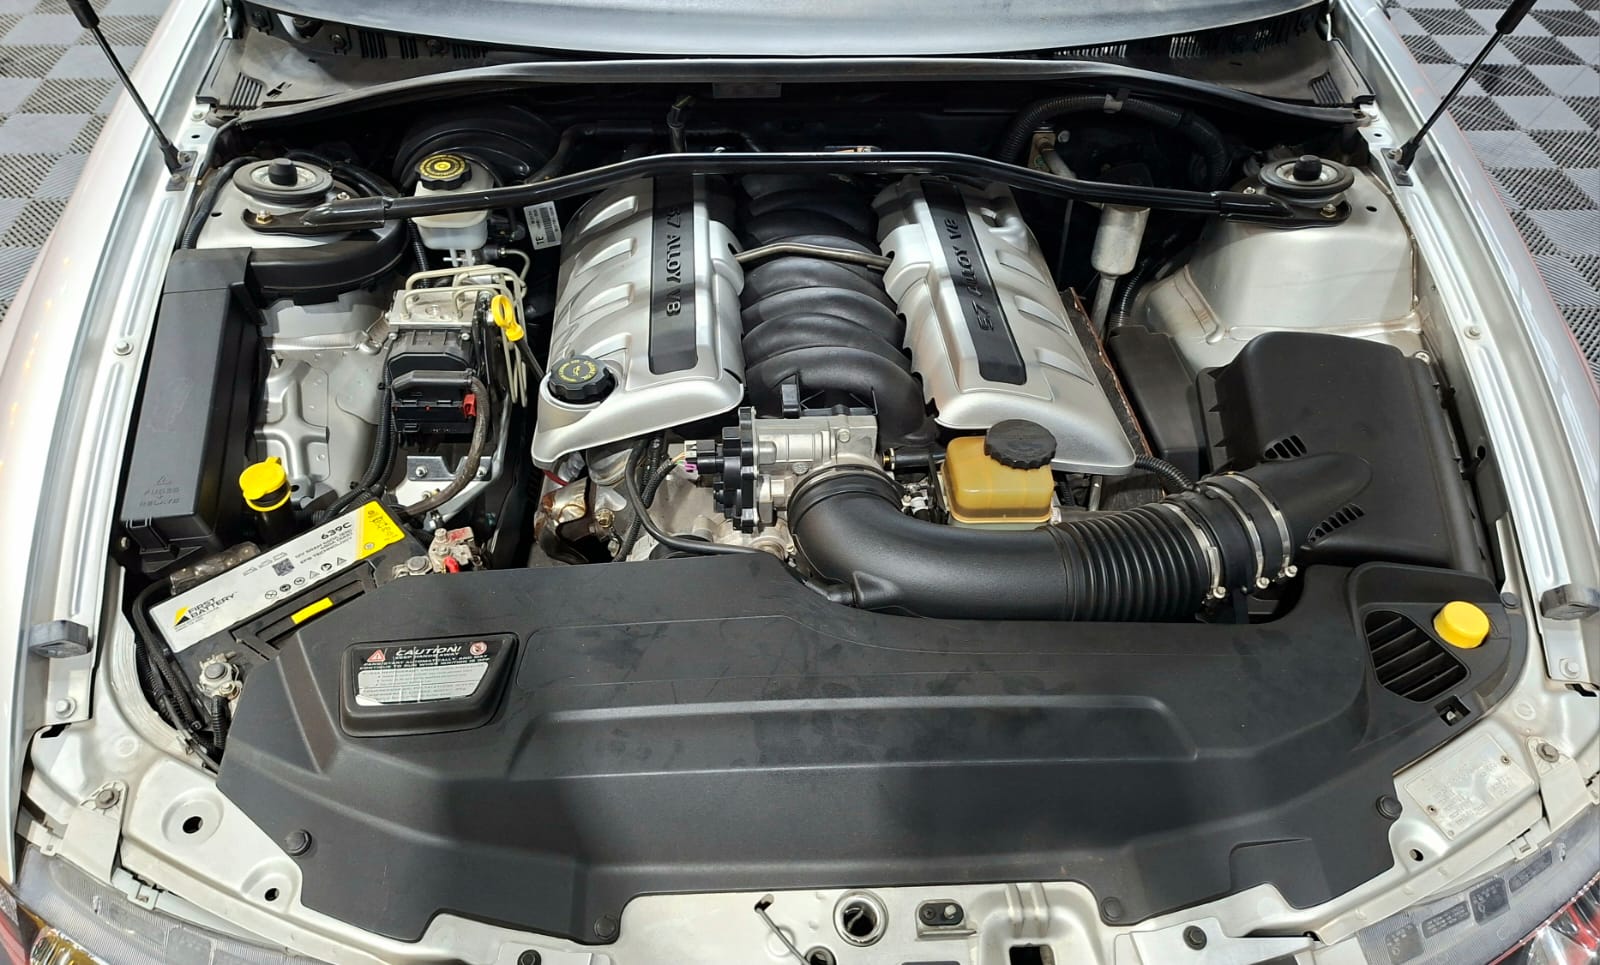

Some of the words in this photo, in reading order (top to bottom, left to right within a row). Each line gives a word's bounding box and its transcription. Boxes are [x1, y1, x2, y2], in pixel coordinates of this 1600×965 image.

[944, 218, 962, 240] V8
[666, 234, 681, 284] ALLOY
[953, 246, 982, 297] ALLOY
[666, 288, 681, 317] V8
[321, 521, 352, 540] 639C
[188, 597, 215, 614] FIRST
[190, 593, 234, 618] BATTERY
[395, 646, 462, 656] CAUTION!
